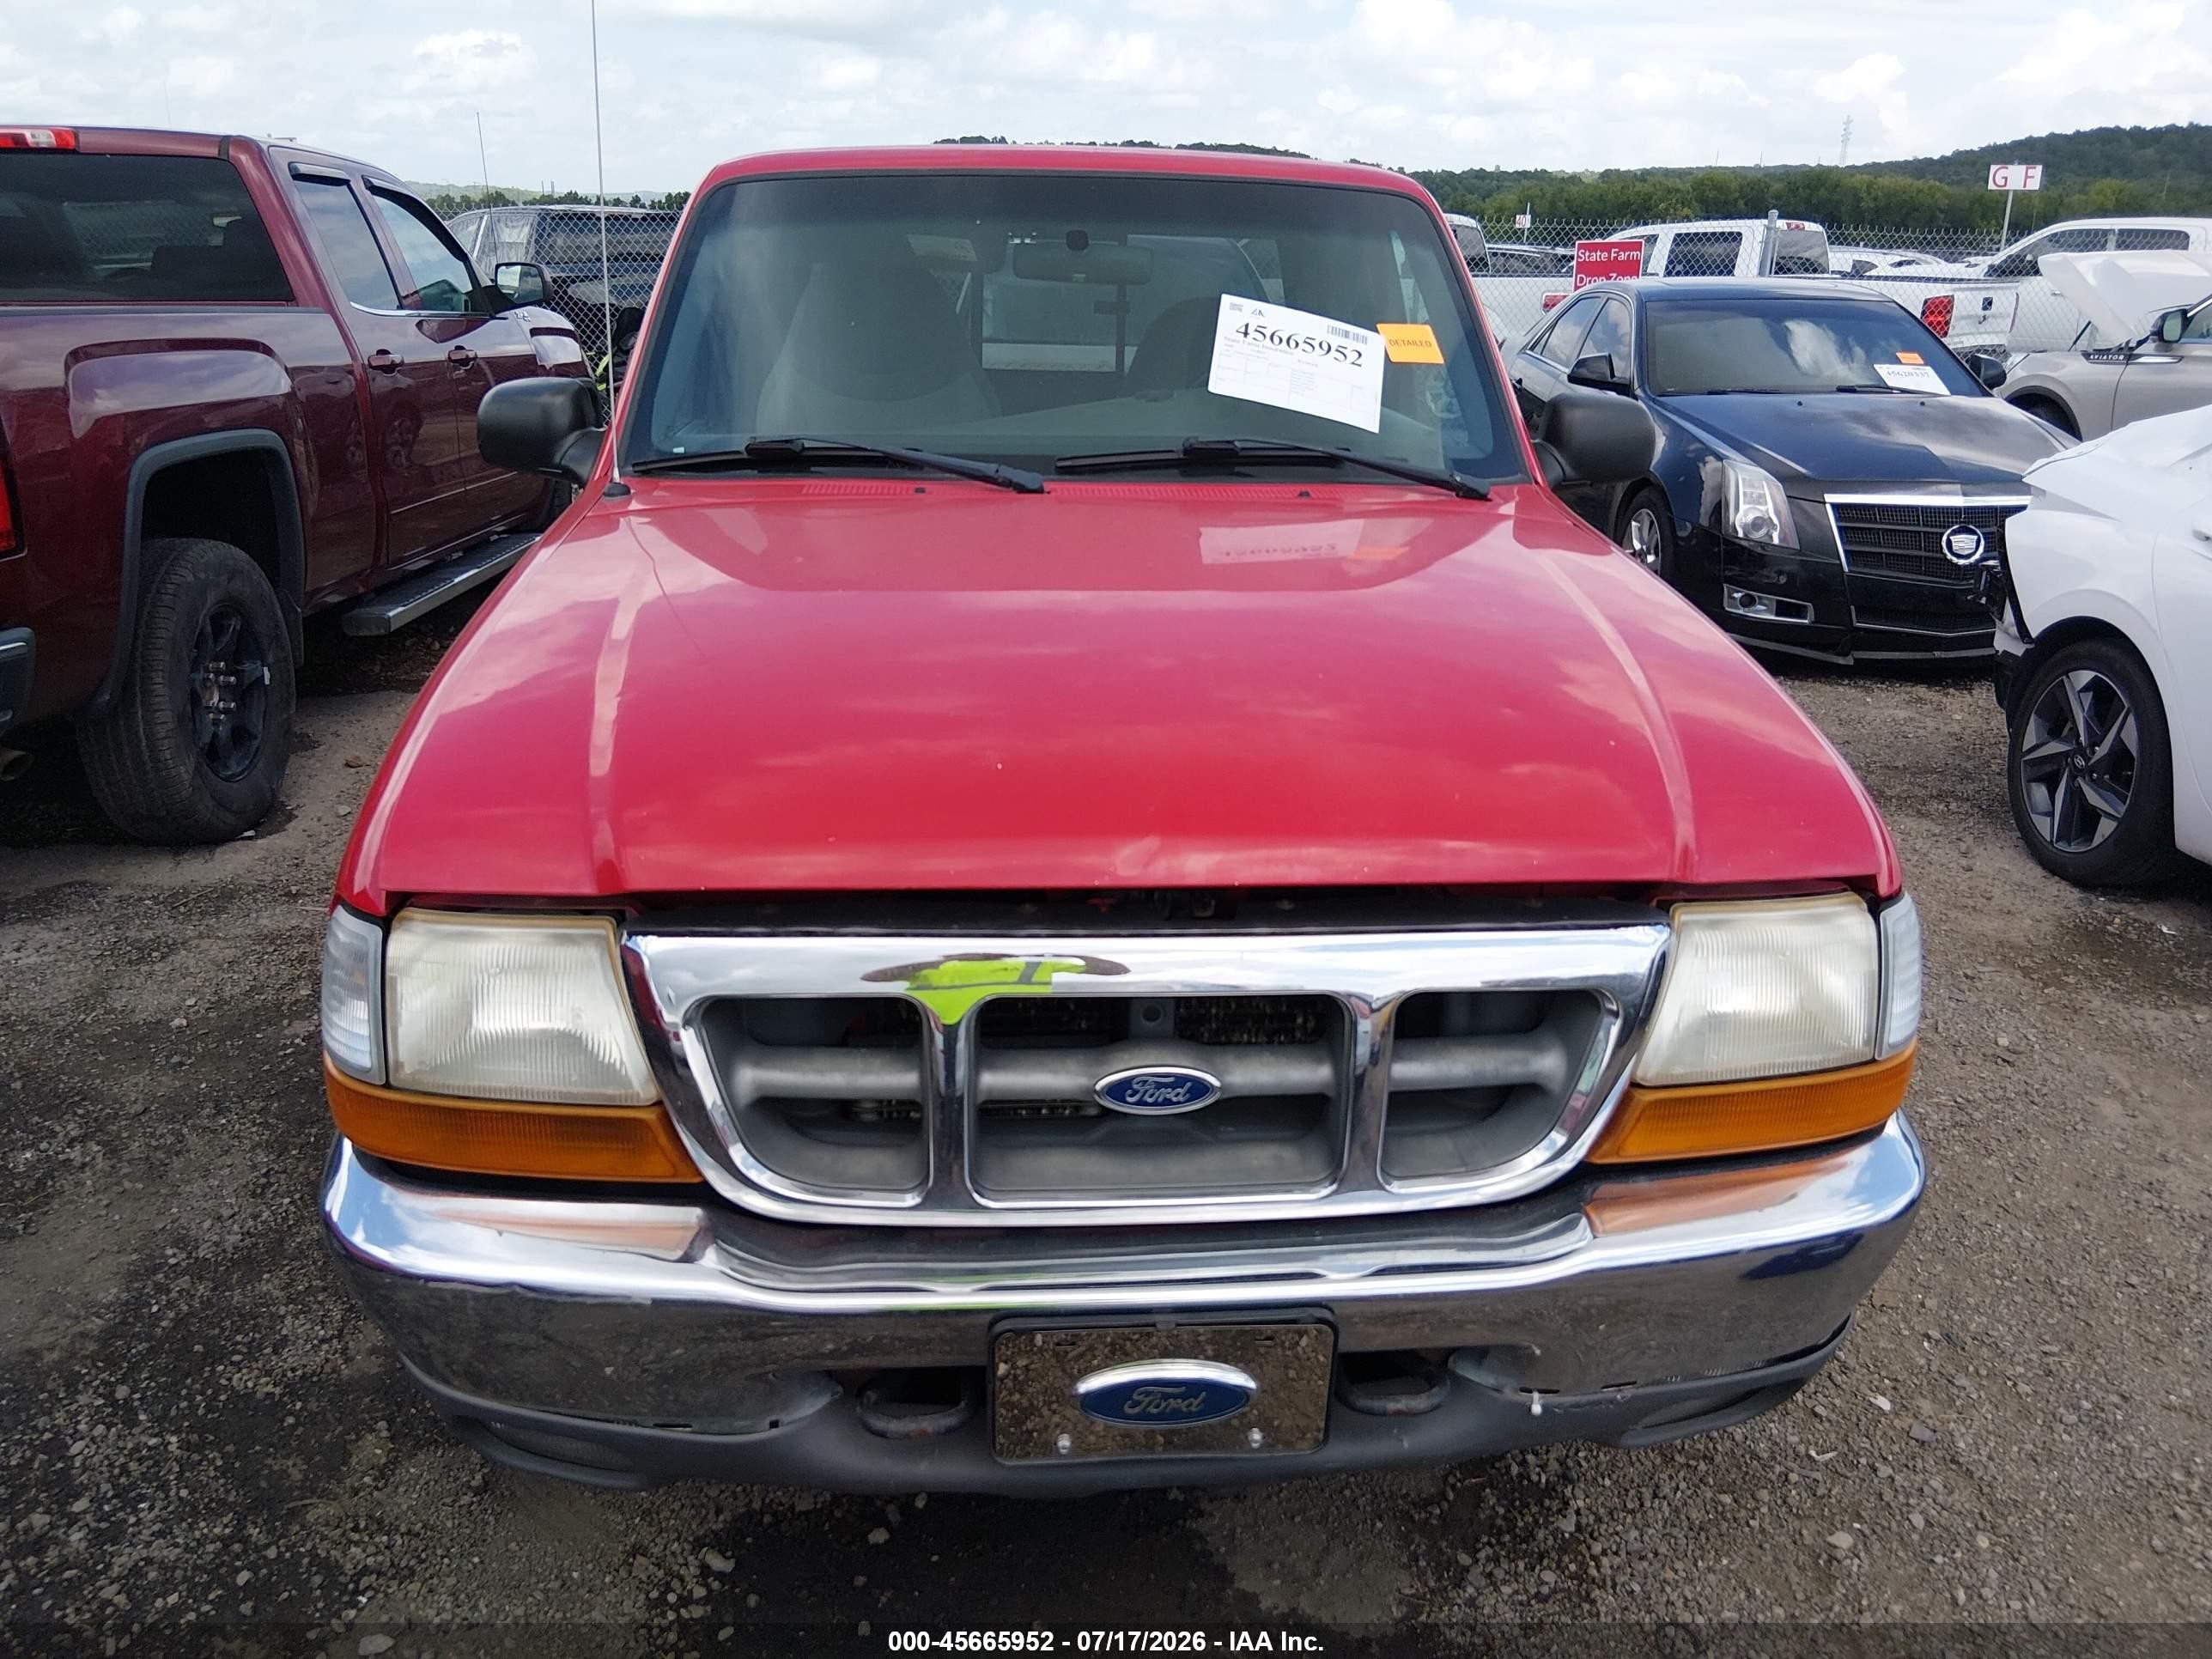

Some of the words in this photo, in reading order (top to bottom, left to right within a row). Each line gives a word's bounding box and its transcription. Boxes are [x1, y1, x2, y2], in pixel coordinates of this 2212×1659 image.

[1992, 166, 2008, 188] G
[2022, 166, 2037, 188] F
[1517, 216, 1527, 228] 40
[1577, 249, 1608, 262] State
[1610, 248, 1641, 261] Farm
[1235, 321, 1364, 368] 45665952
[1389, 339, 1432, 348] DETAILED
[1125, 1076, 1193, 1103] Ford
[1123, 1385, 1206, 1415] Ford
